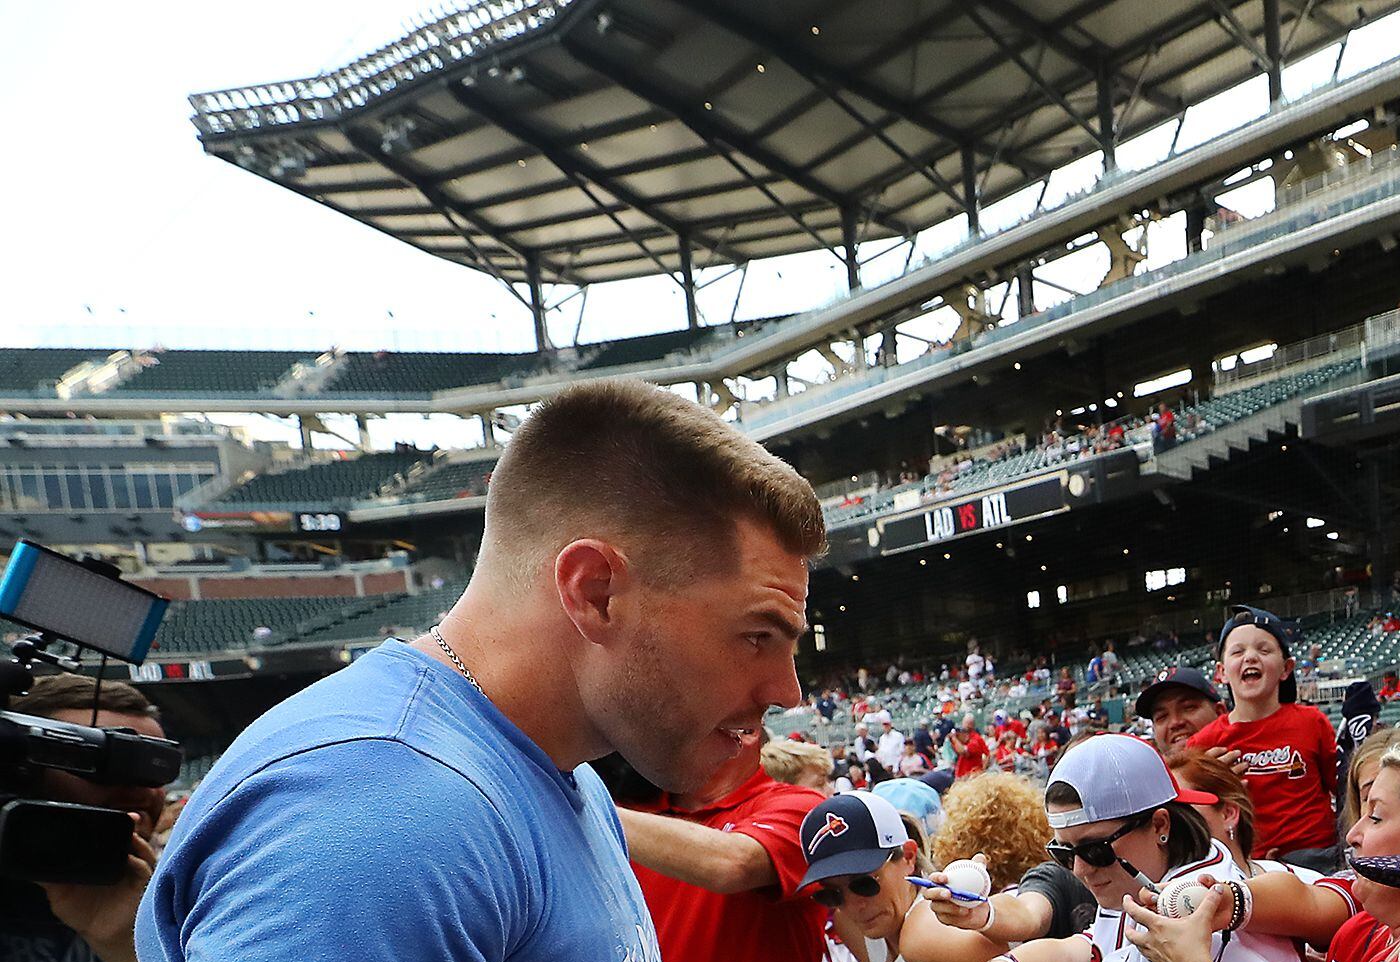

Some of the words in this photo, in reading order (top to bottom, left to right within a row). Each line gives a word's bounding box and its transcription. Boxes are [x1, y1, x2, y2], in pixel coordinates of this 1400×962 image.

[924, 506, 956, 541] LAD
[957, 503, 977, 529] VS
[981, 492, 1012, 528] ATL
